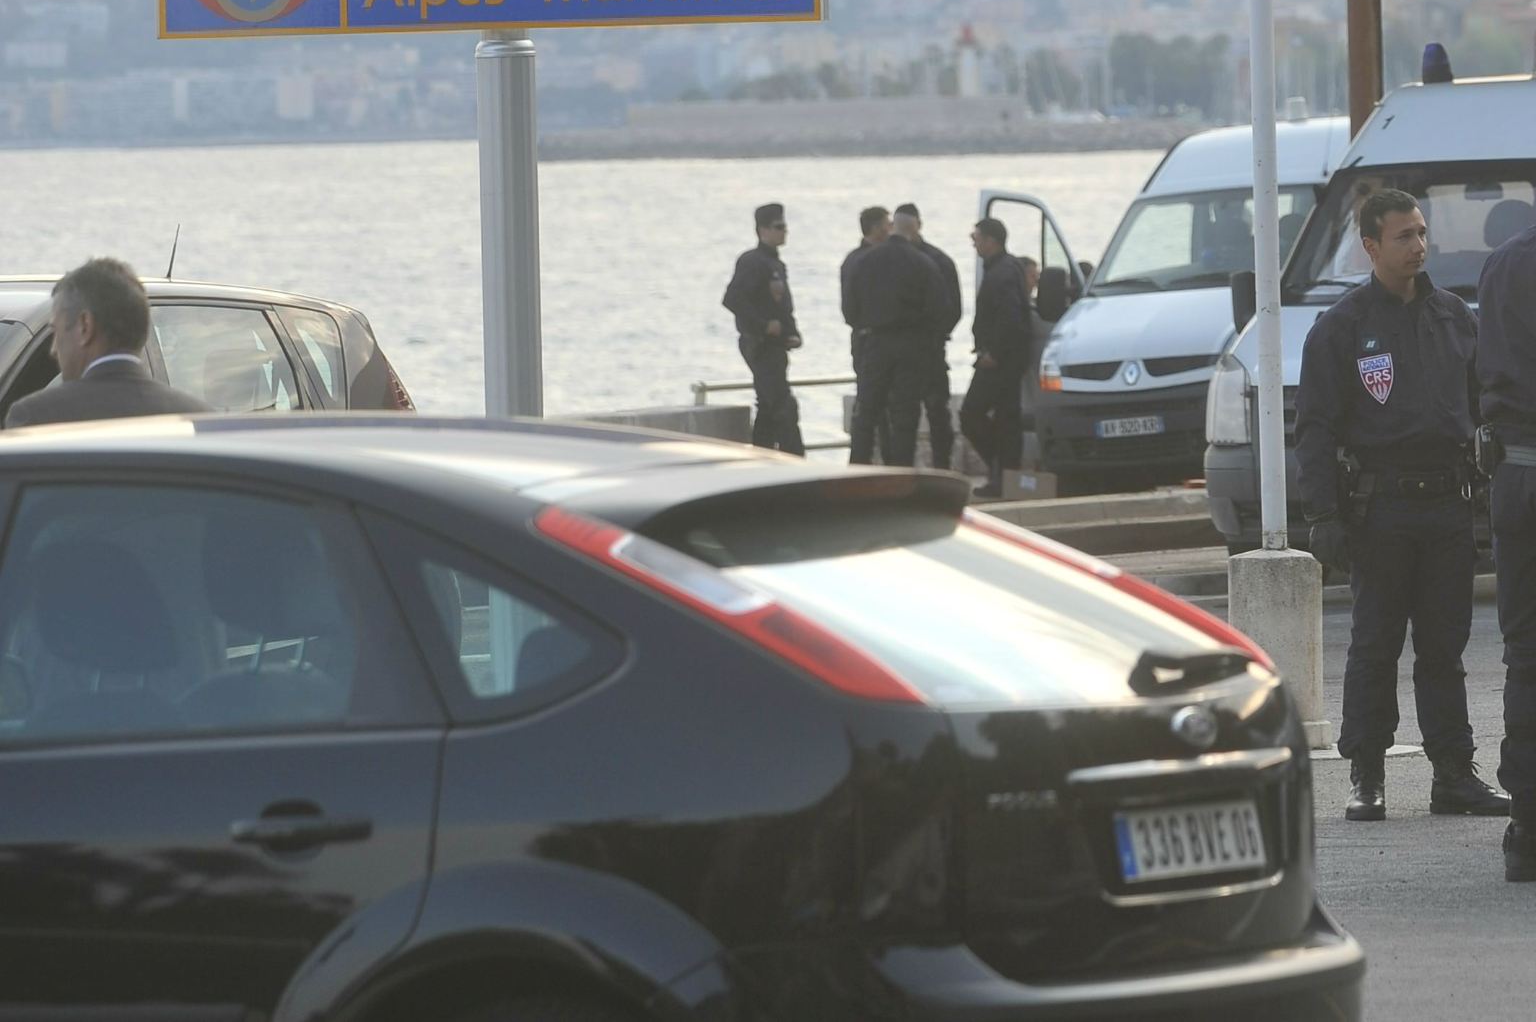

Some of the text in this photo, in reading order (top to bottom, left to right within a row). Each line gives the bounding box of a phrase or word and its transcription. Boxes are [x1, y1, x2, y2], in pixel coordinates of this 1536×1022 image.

[1365, 369, 1391, 385] CRS
[1137, 806, 1259, 868] 336 BVE 06
